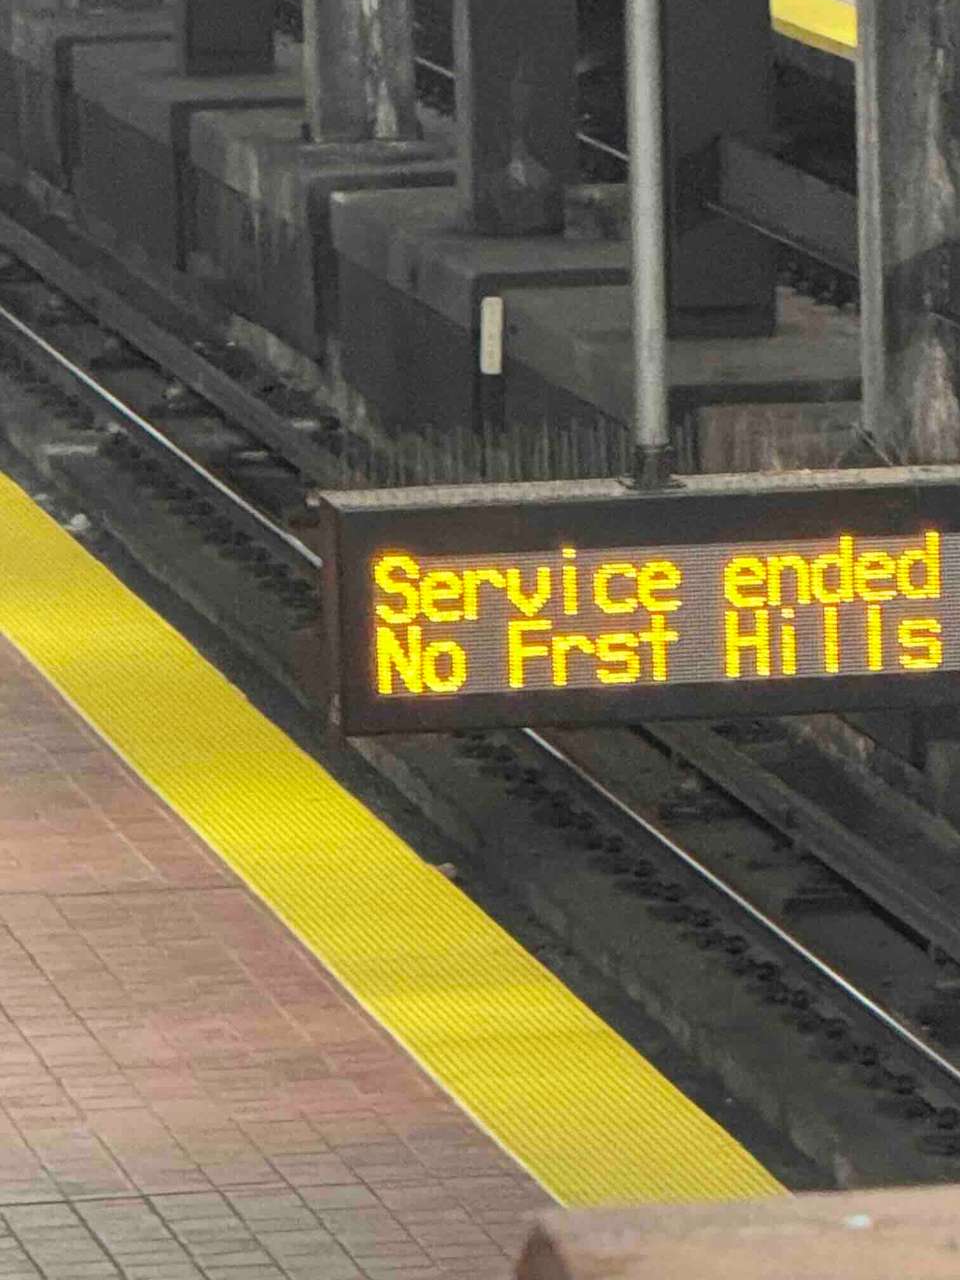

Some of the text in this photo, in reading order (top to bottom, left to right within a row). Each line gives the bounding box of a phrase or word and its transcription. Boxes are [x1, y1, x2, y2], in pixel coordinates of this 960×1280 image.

[374, 549, 682, 624] Service
[723, 533, 940, 607] ended
[376, 624, 467, 695] No
[507, 613, 680, 688] Frst
[724, 604, 942, 678] Hills
